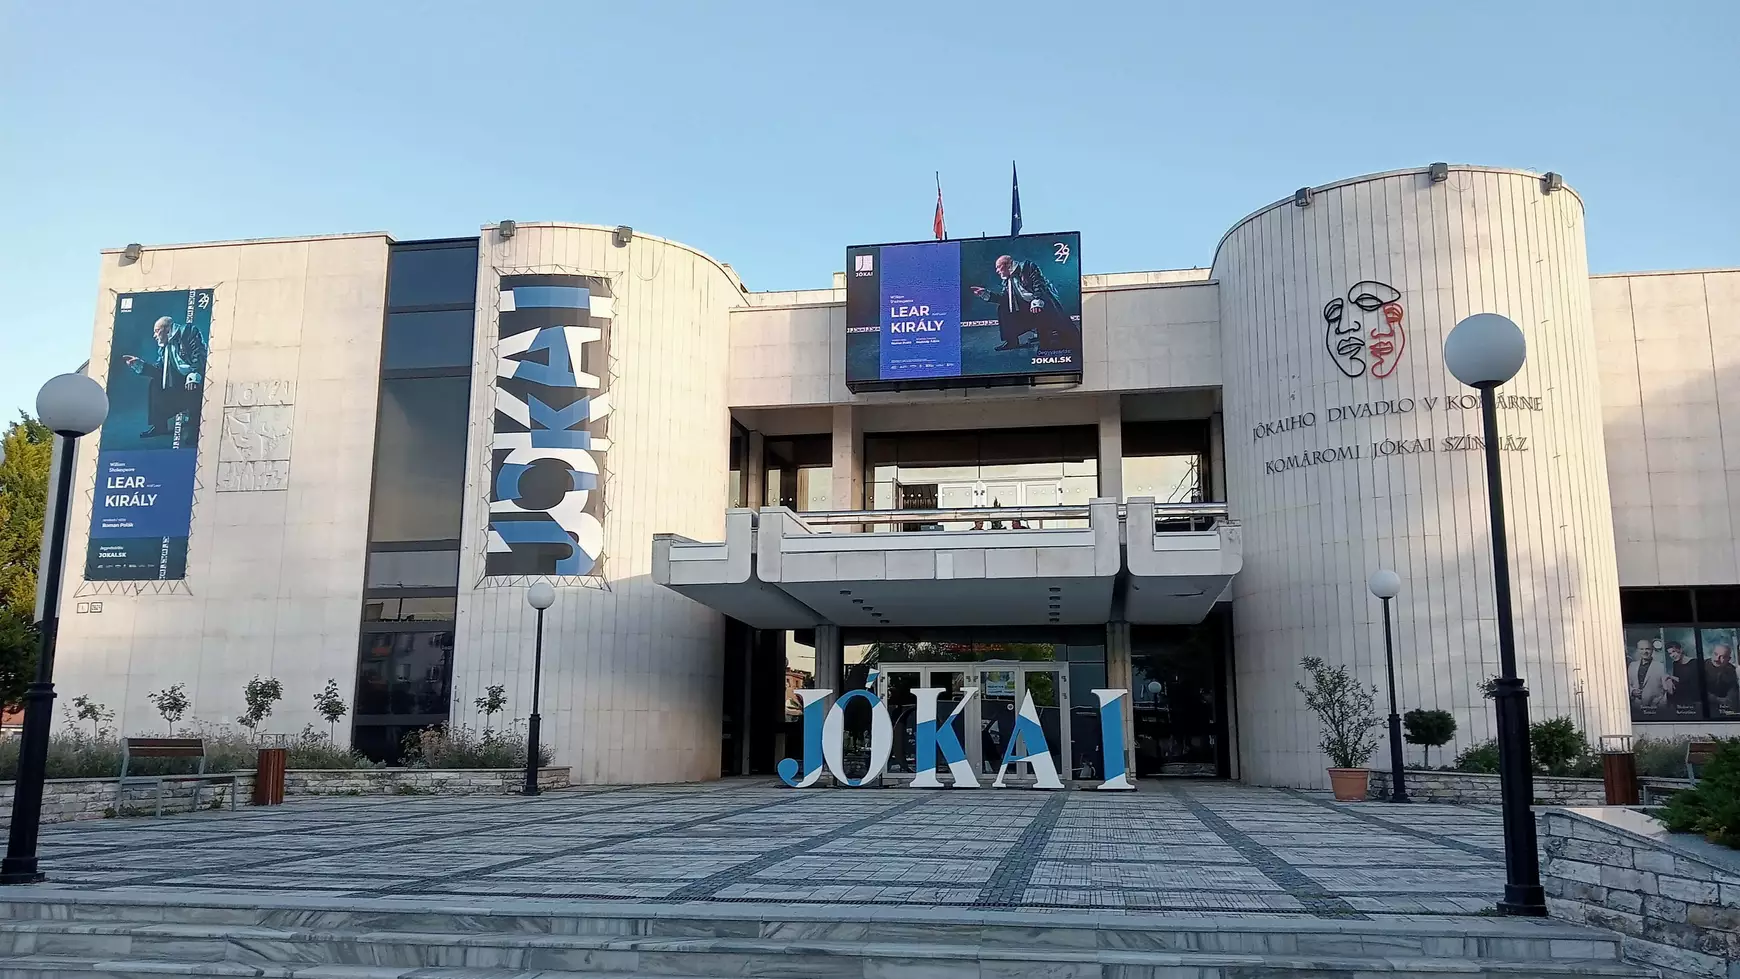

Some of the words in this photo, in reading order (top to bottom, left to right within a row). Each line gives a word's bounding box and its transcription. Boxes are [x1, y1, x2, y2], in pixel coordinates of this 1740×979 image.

[891, 305, 930, 318] LEAR
[891, 318, 944, 334] KIRÁLY
[1031, 356, 1072, 365] JOKAI.SK
[1327, 397, 1415, 423] DIVADLO
[1424, 396, 1438, 411] V
[1446, 392, 1543, 412] KOÁRNE
[1265, 447, 1360, 475] KOMÁROMI
[1372, 437, 1434, 460] JÓKAI
[107, 476, 146, 489] LEAR
[104, 491, 158, 507] KIRÁLY
[777, 668, 1136, 790] JÓKAI
